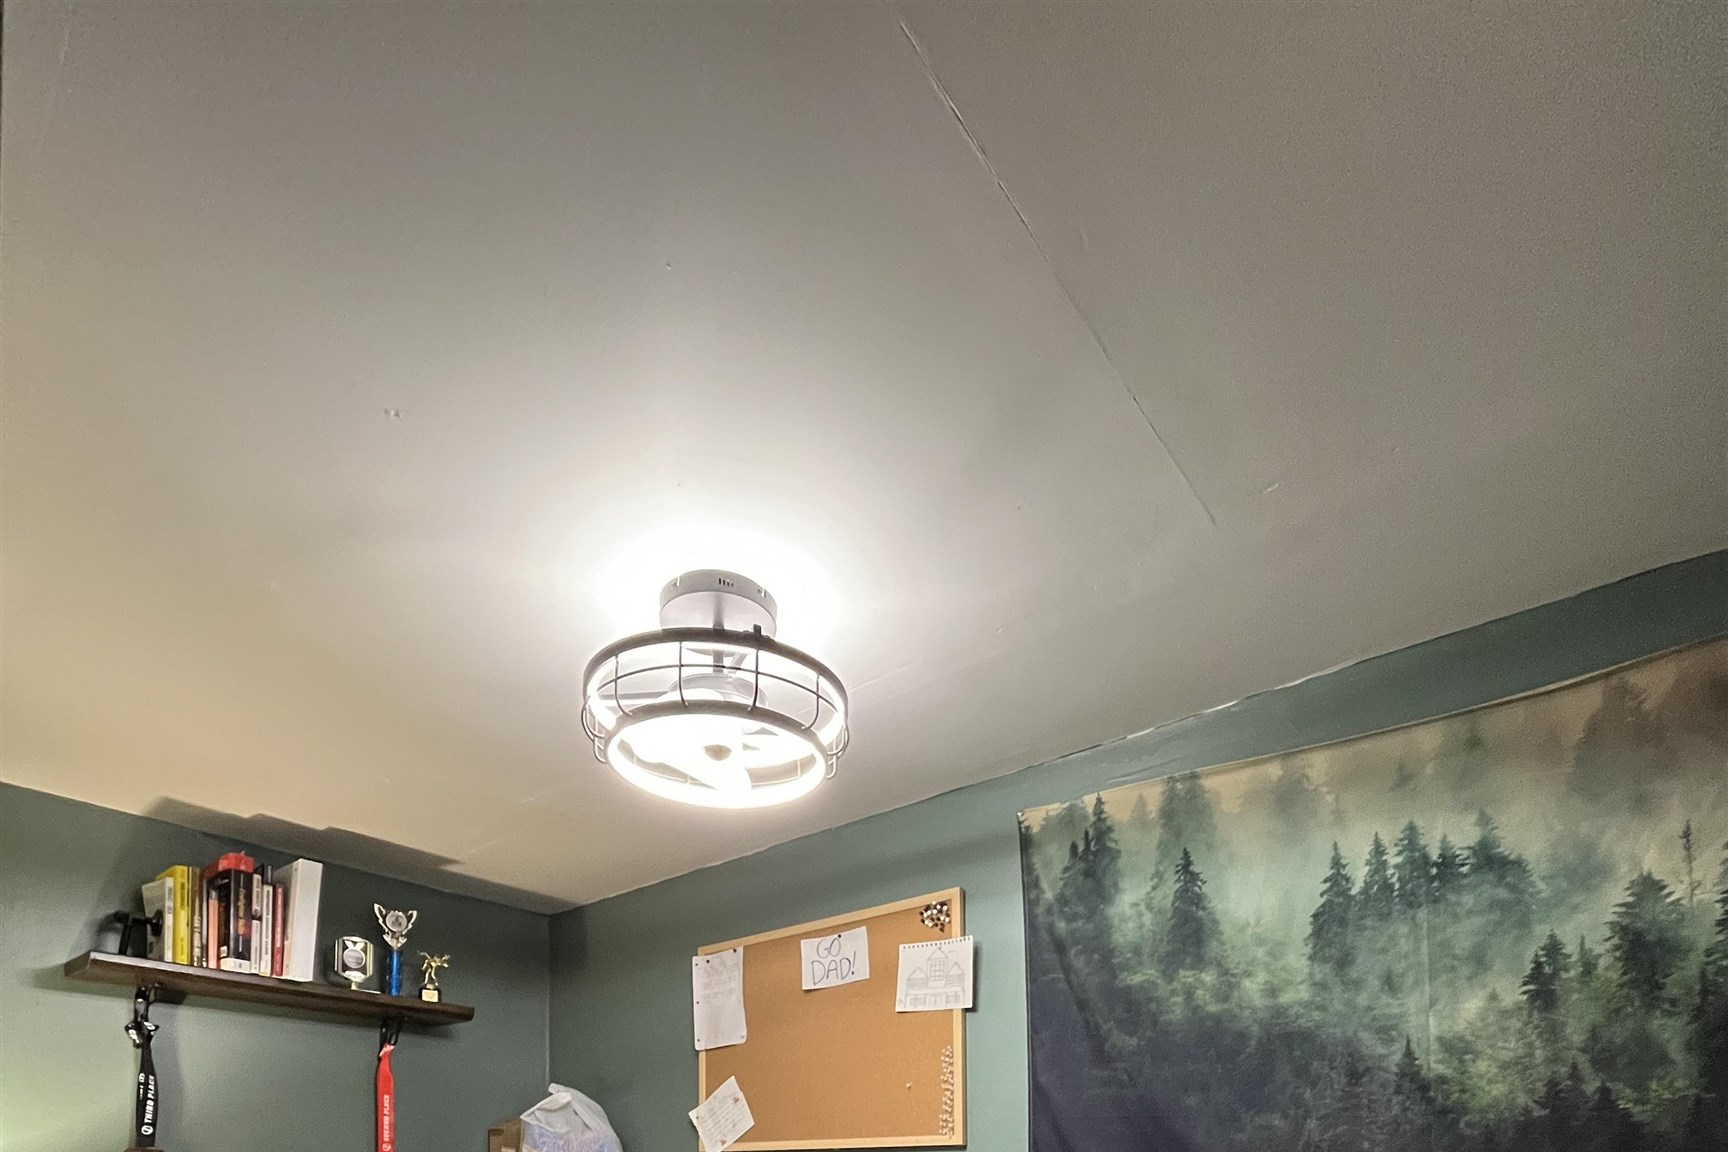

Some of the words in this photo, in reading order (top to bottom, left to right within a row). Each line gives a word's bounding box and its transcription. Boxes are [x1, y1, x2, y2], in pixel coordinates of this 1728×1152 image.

[816, 937, 841, 959] GO
[811, 950, 856, 986] DAD!
[144, 1100, 154, 1123] THIRD
